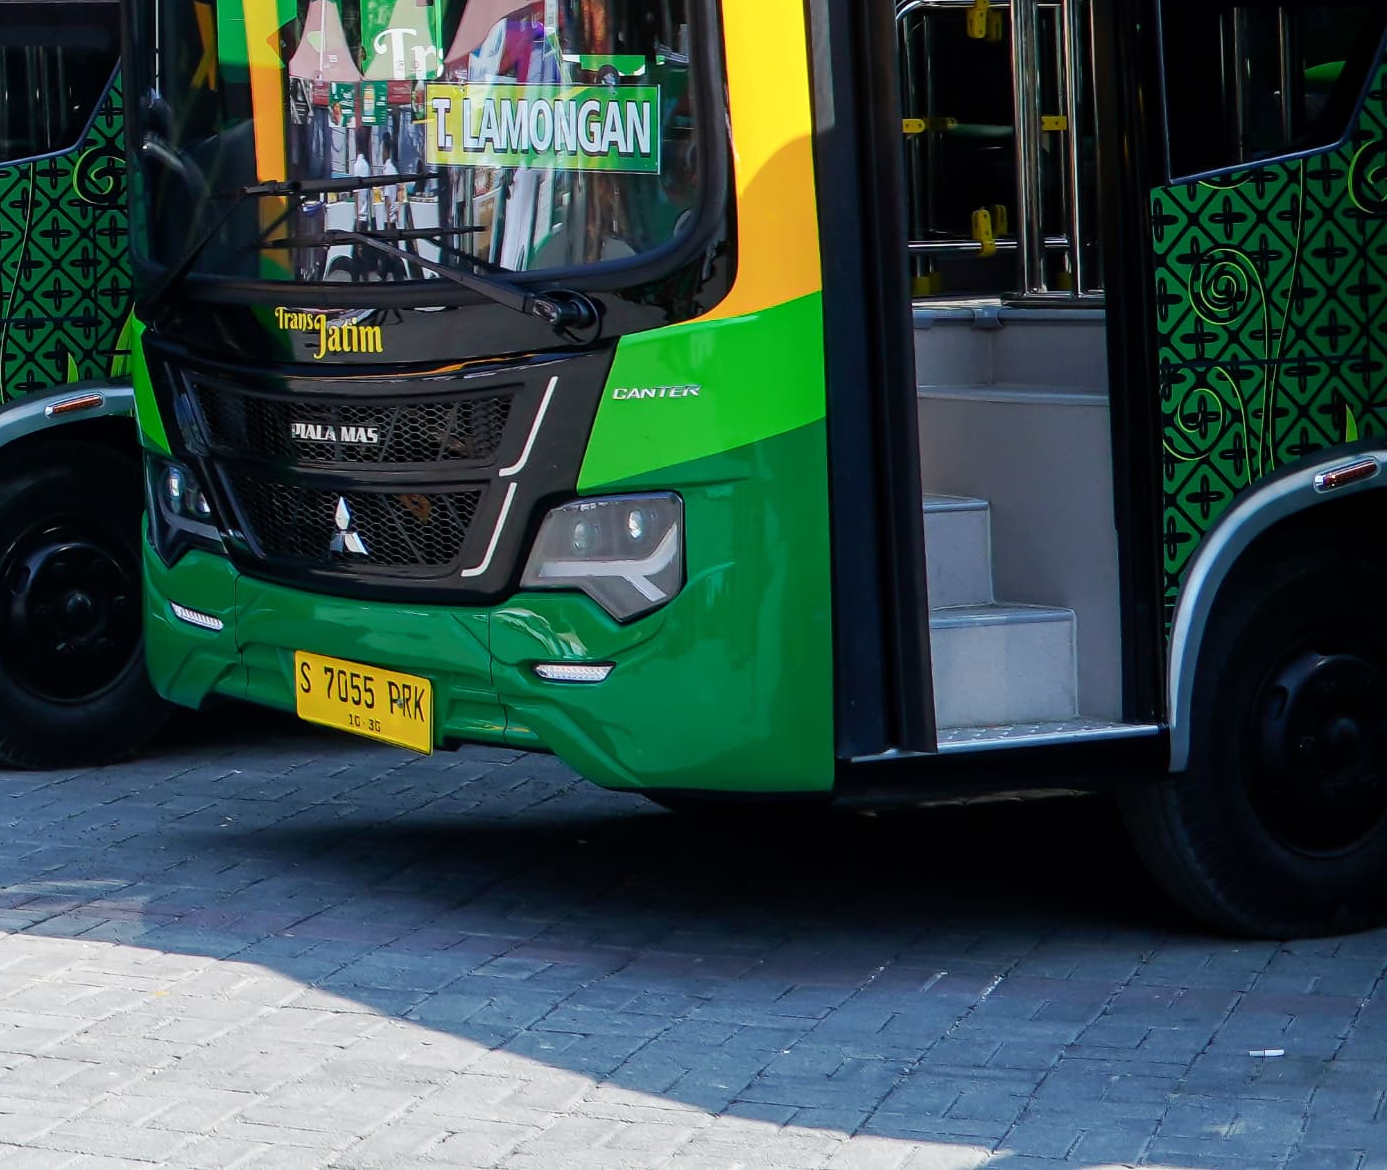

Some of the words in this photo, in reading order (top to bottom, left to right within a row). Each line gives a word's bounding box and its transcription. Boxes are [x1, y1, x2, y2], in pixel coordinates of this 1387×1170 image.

[431, 97, 453, 151] T.
[463, 98, 652, 157] LAMONGAN
[274, 306, 314, 331] Trans
[313, 314, 384, 359] Jatim
[612, 384, 702, 400] CANTER
[291, 423, 337, 442] PIALA
[340, 426, 379, 444] MAS
[300, 661, 311, 693] S
[323, 666, 375, 709] 7055
[387, 681, 425, 723] PRK
